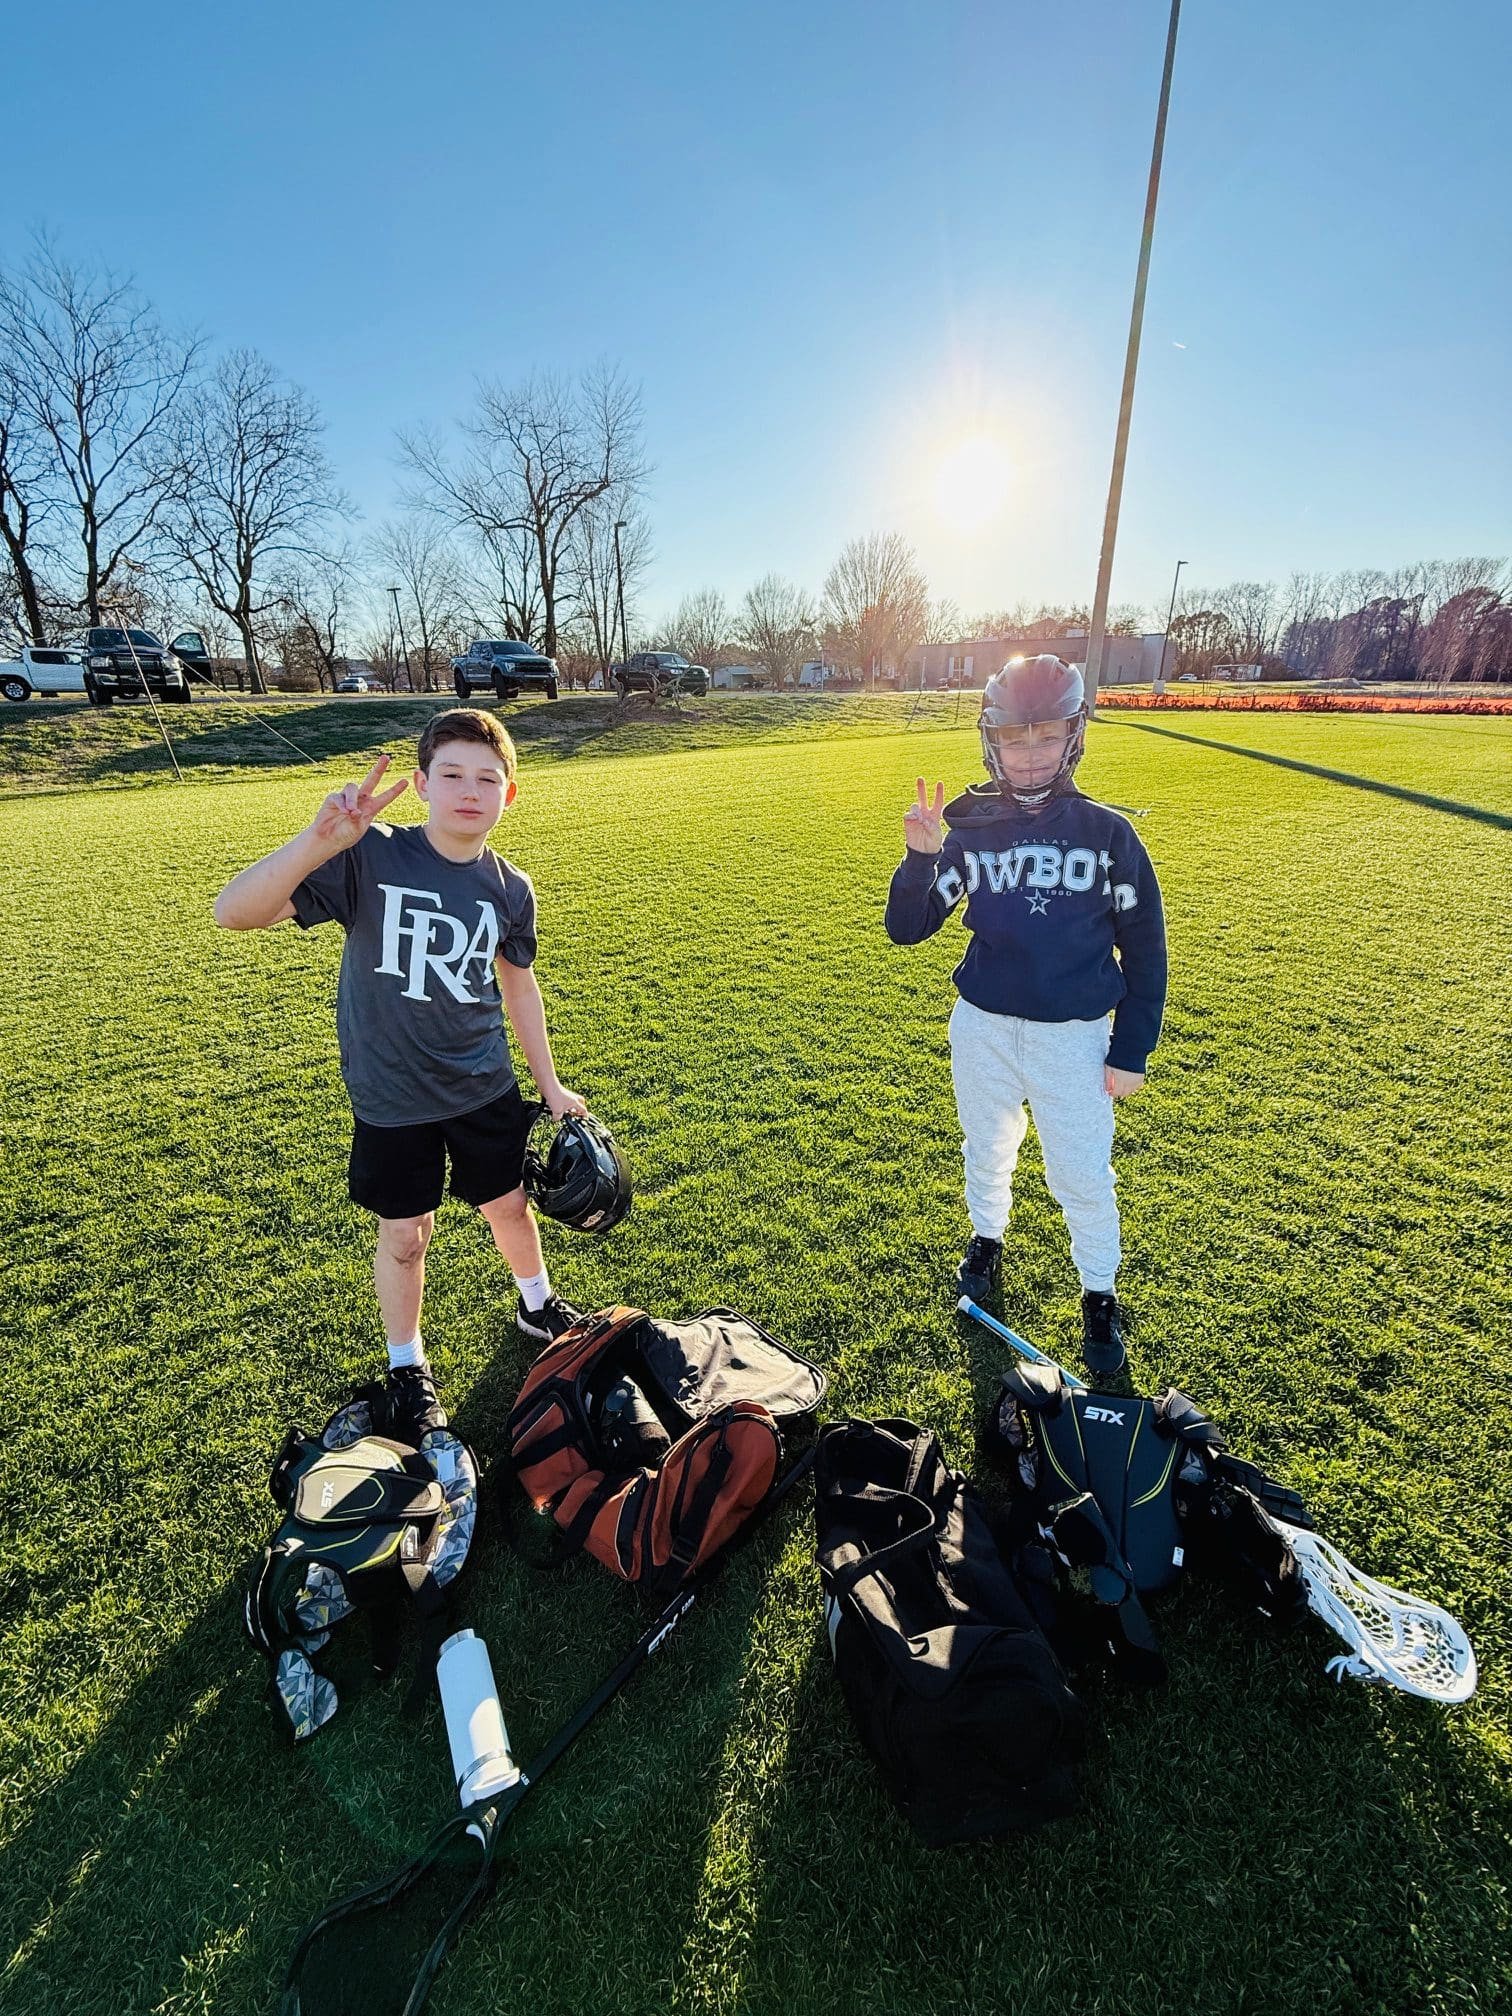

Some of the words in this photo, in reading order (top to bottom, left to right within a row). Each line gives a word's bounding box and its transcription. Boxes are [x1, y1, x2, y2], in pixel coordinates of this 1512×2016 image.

[1012, 838, 1068, 847] DALLAS
[374, 884, 499, 1004] FRA
[1083, 1405, 1126, 1426] STX
[320, 1480, 335, 1509] STX
